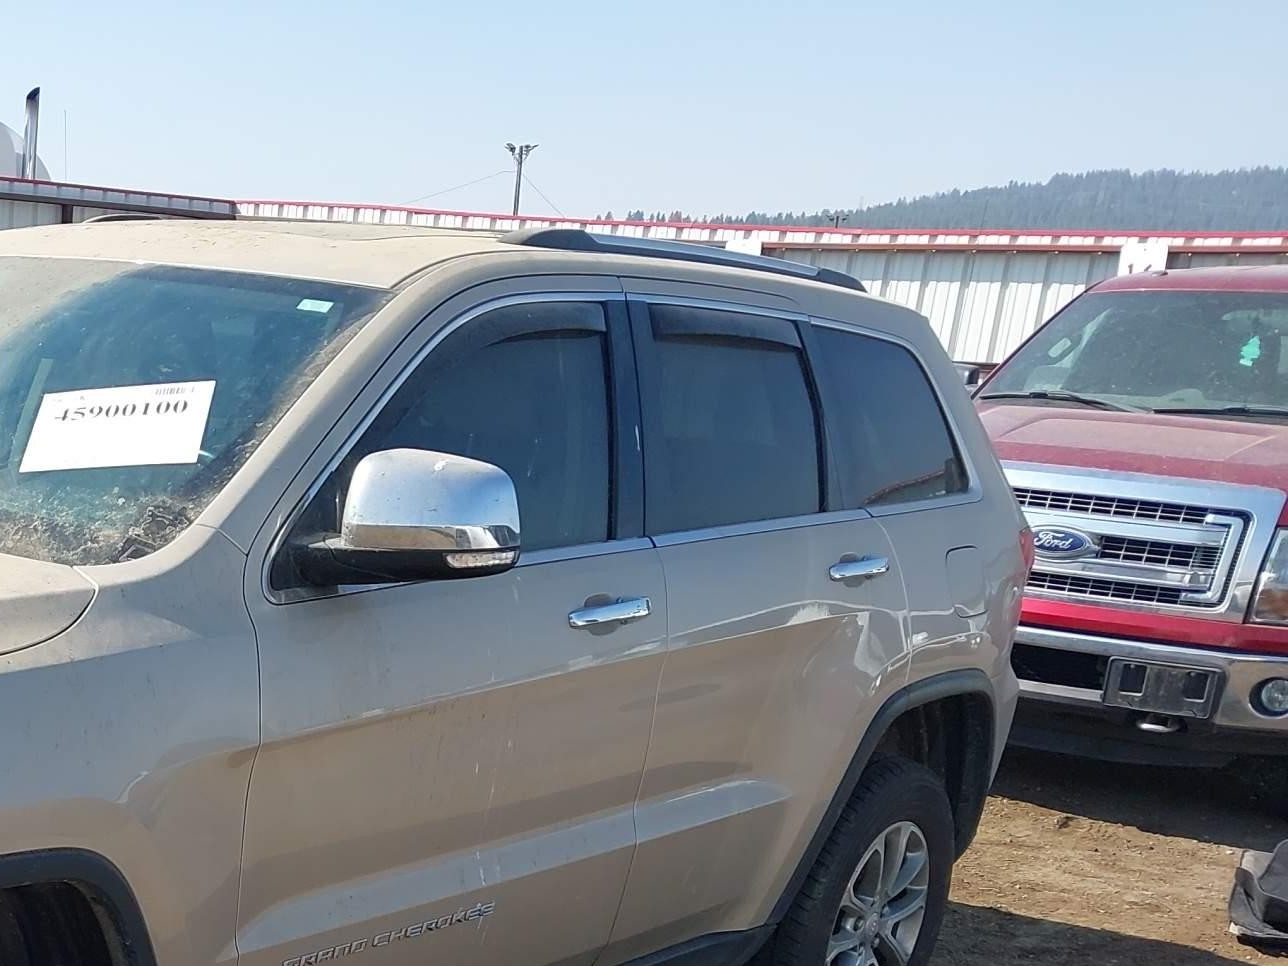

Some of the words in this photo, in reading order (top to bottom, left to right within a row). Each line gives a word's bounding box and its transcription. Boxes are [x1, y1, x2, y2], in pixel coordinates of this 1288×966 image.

[54, 400, 188, 421] 45900100
[1034, 532, 1073, 549] Ford
[371, 901, 496, 947] CHEROKEE
